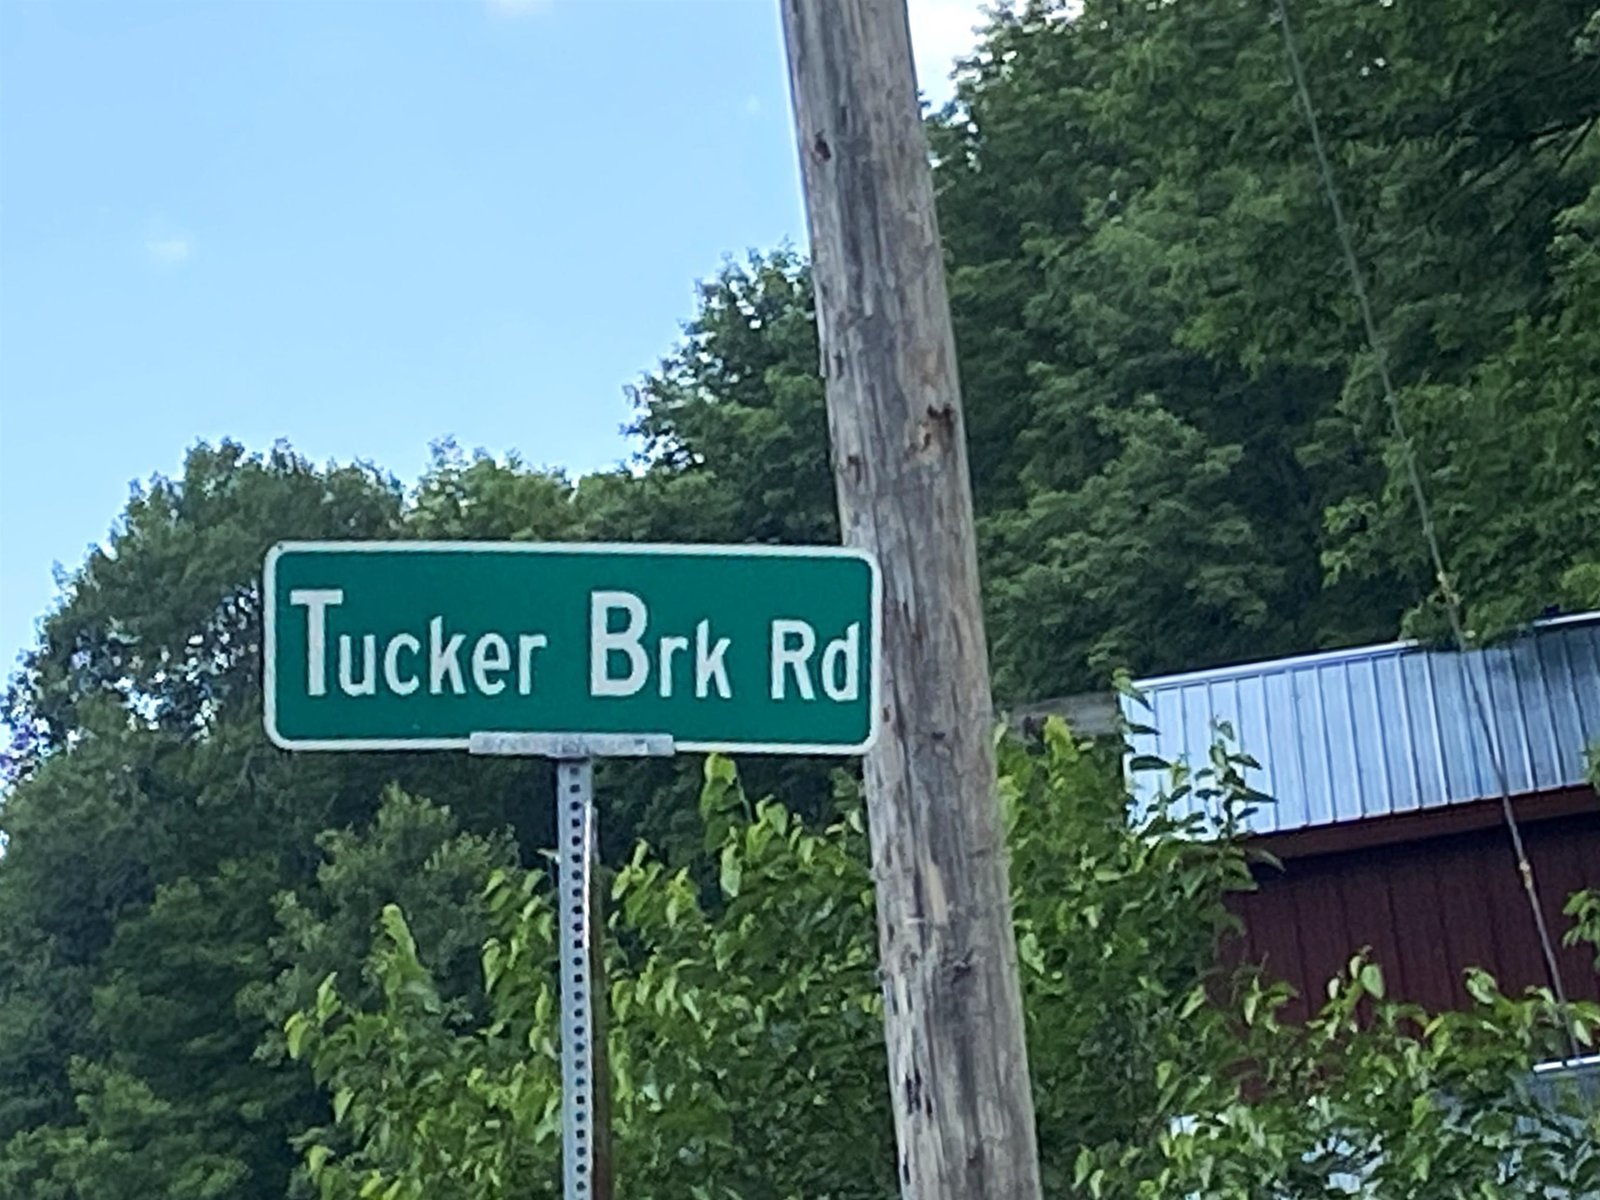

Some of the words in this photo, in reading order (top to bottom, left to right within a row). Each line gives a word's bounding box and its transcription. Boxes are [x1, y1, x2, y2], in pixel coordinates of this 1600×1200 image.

[290, 589, 548, 697] Tucker
[590, 591, 732, 699] Brk
[771, 619, 860, 702] Rd
